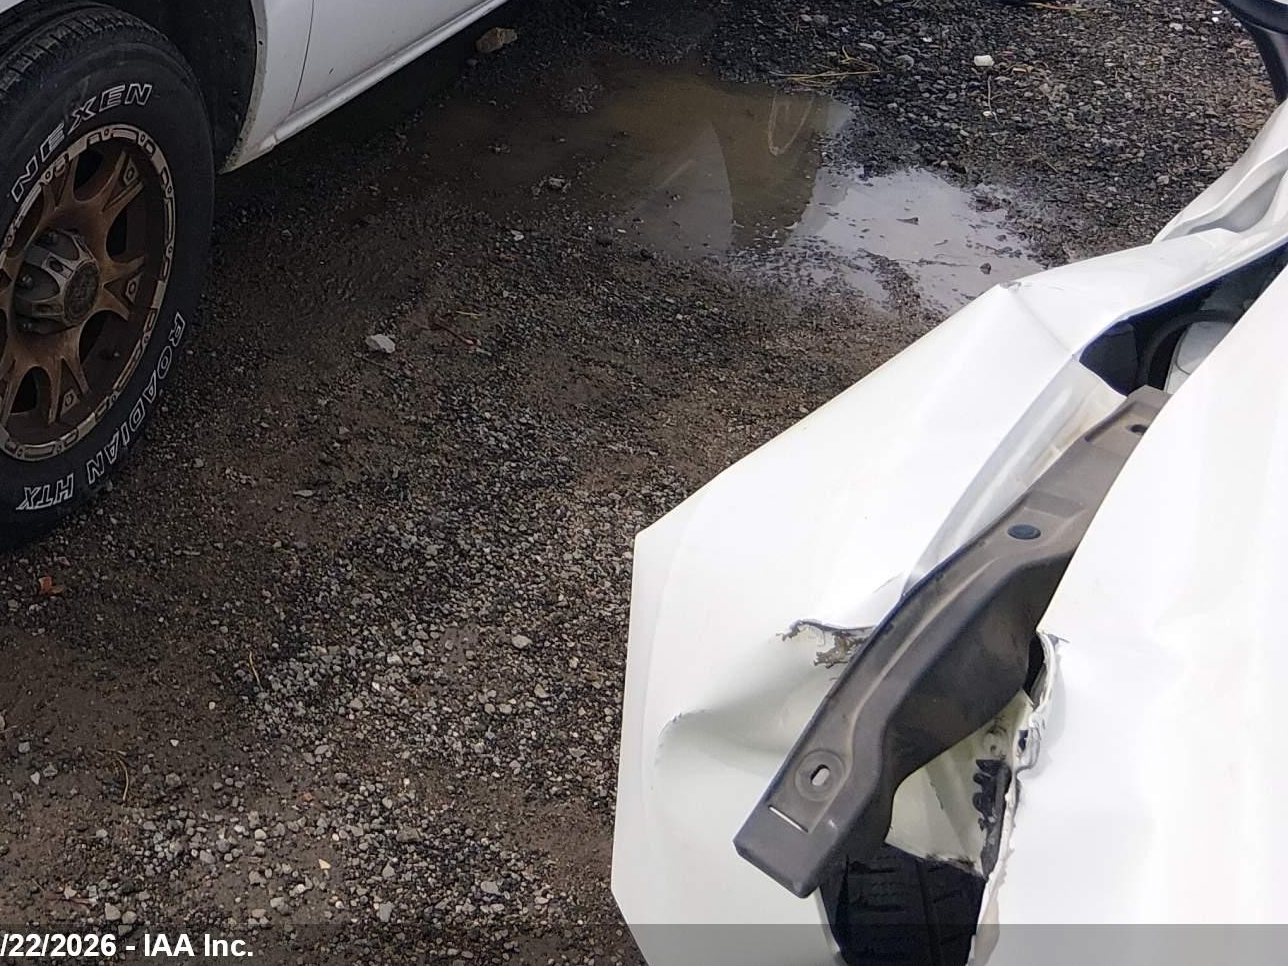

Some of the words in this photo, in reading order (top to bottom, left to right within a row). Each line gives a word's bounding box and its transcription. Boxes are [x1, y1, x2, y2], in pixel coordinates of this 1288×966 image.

[11, 83, 153, 203] NEXEN
[85, 311, 186, 485] ROADIAN
[16, 472, 74, 511] HTX
